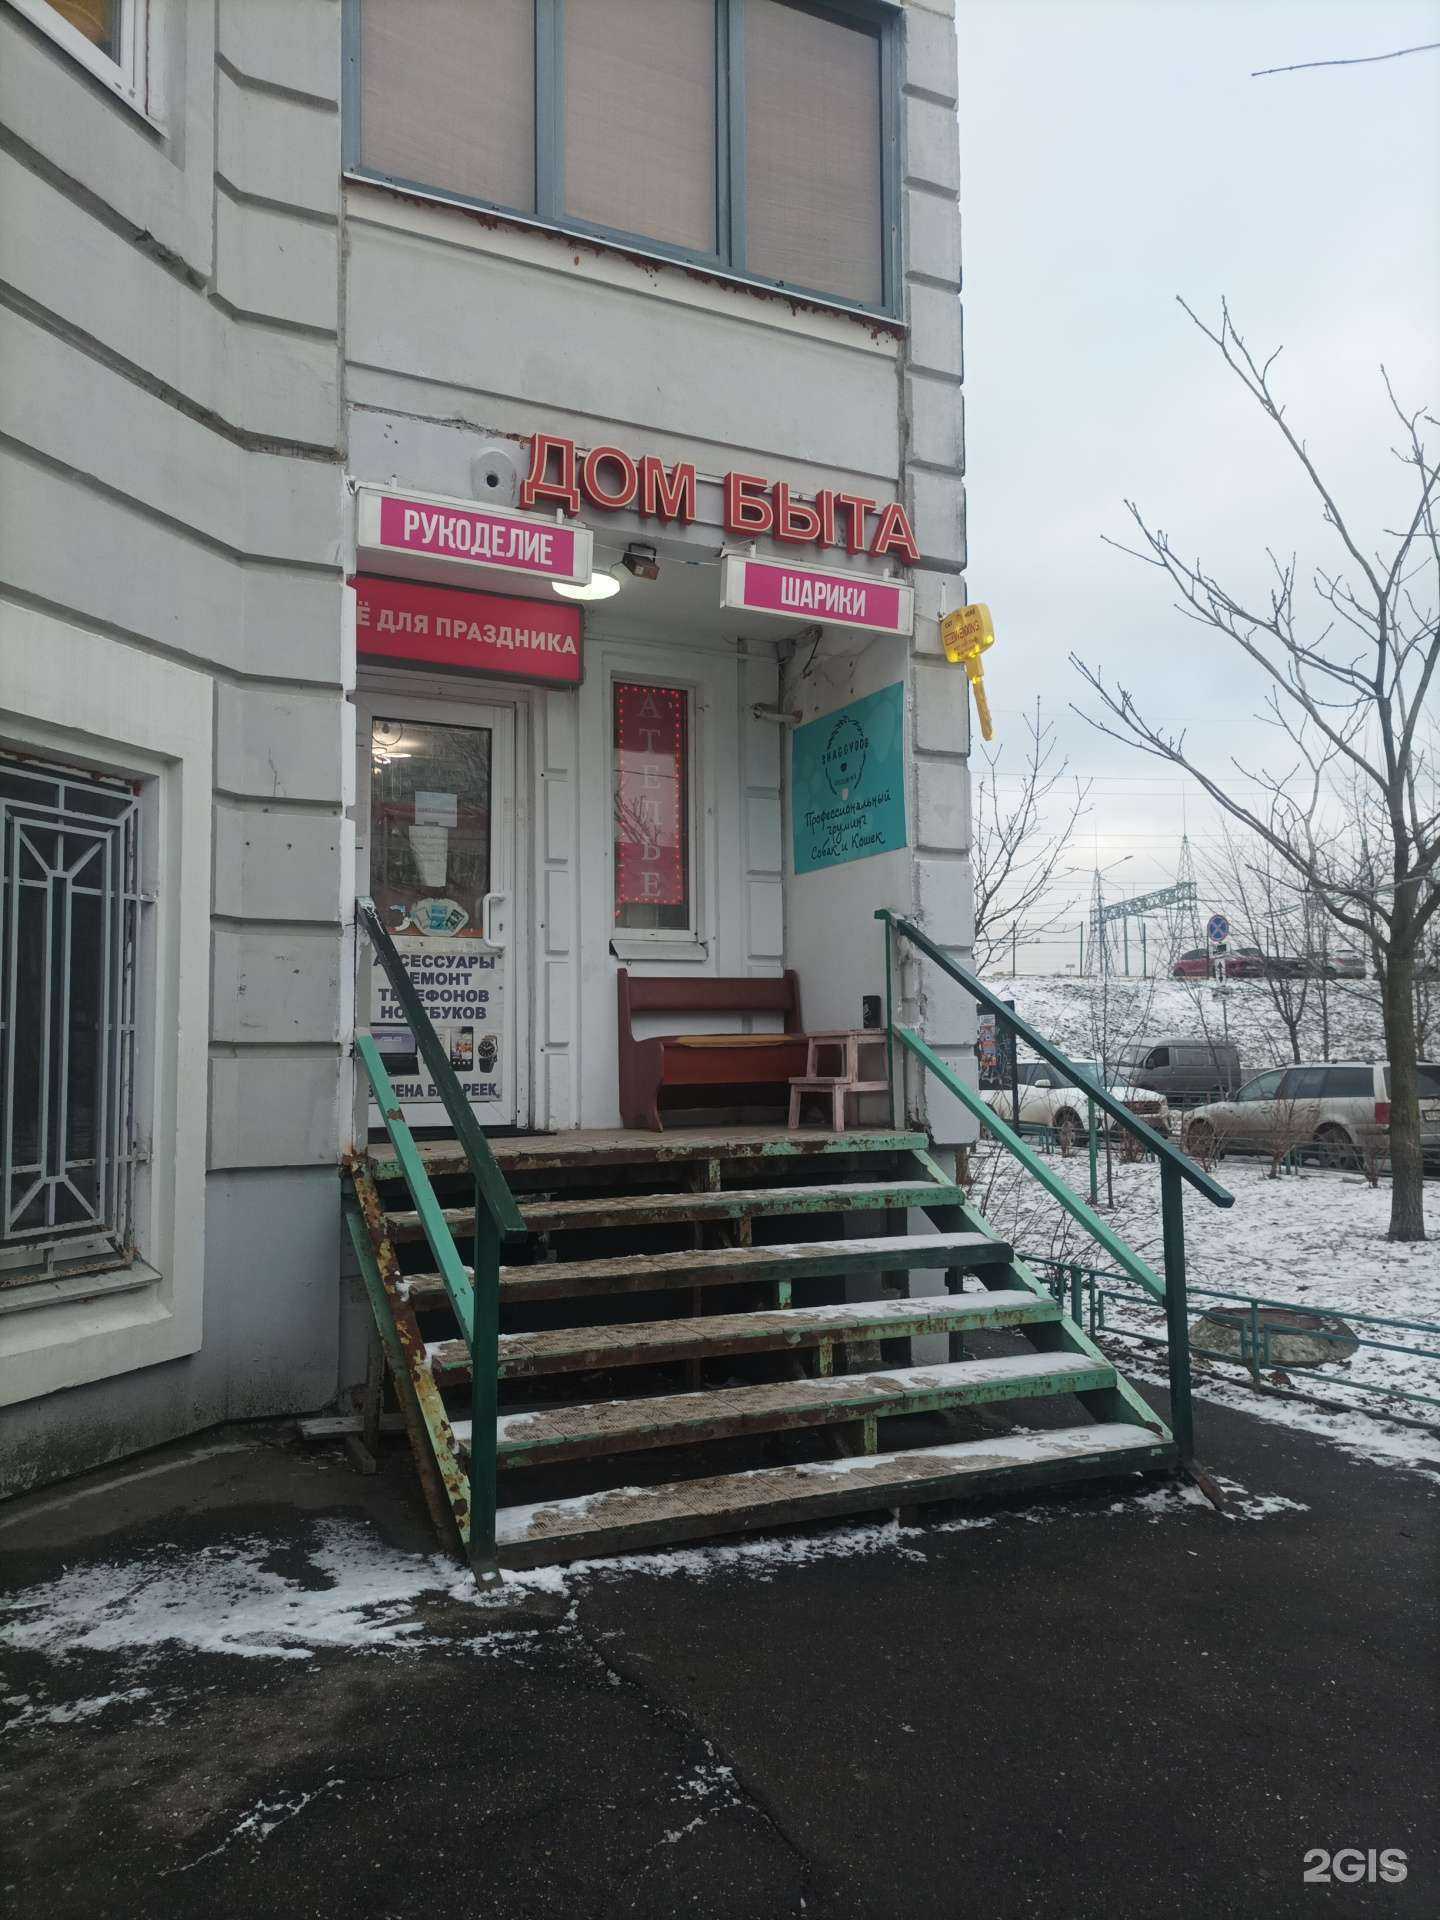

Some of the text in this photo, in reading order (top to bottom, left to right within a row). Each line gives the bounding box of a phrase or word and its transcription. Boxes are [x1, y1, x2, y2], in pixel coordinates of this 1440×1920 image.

[520, 433, 921, 564] ДОМ БЫТА
[403, 509, 553, 565] РУКОДЕЛИЕ
[780, 575, 867, 617] ШАРИКИ
[377, 609, 429, 634] ДЛЯ
[436, 616, 577, 655] ПРАЗДНИКА
[805, 790, 891, 833] Профессиональный
[811, 831, 886, 860] Собак и Кошек
[828, 815, 867, 844] груминг
[378, 989, 490, 1002] ТЕЕФОНОВ
[409, 972, 472, 985] ЕМОНТ
[381, 1006, 487, 1019] НОБУКОВ
